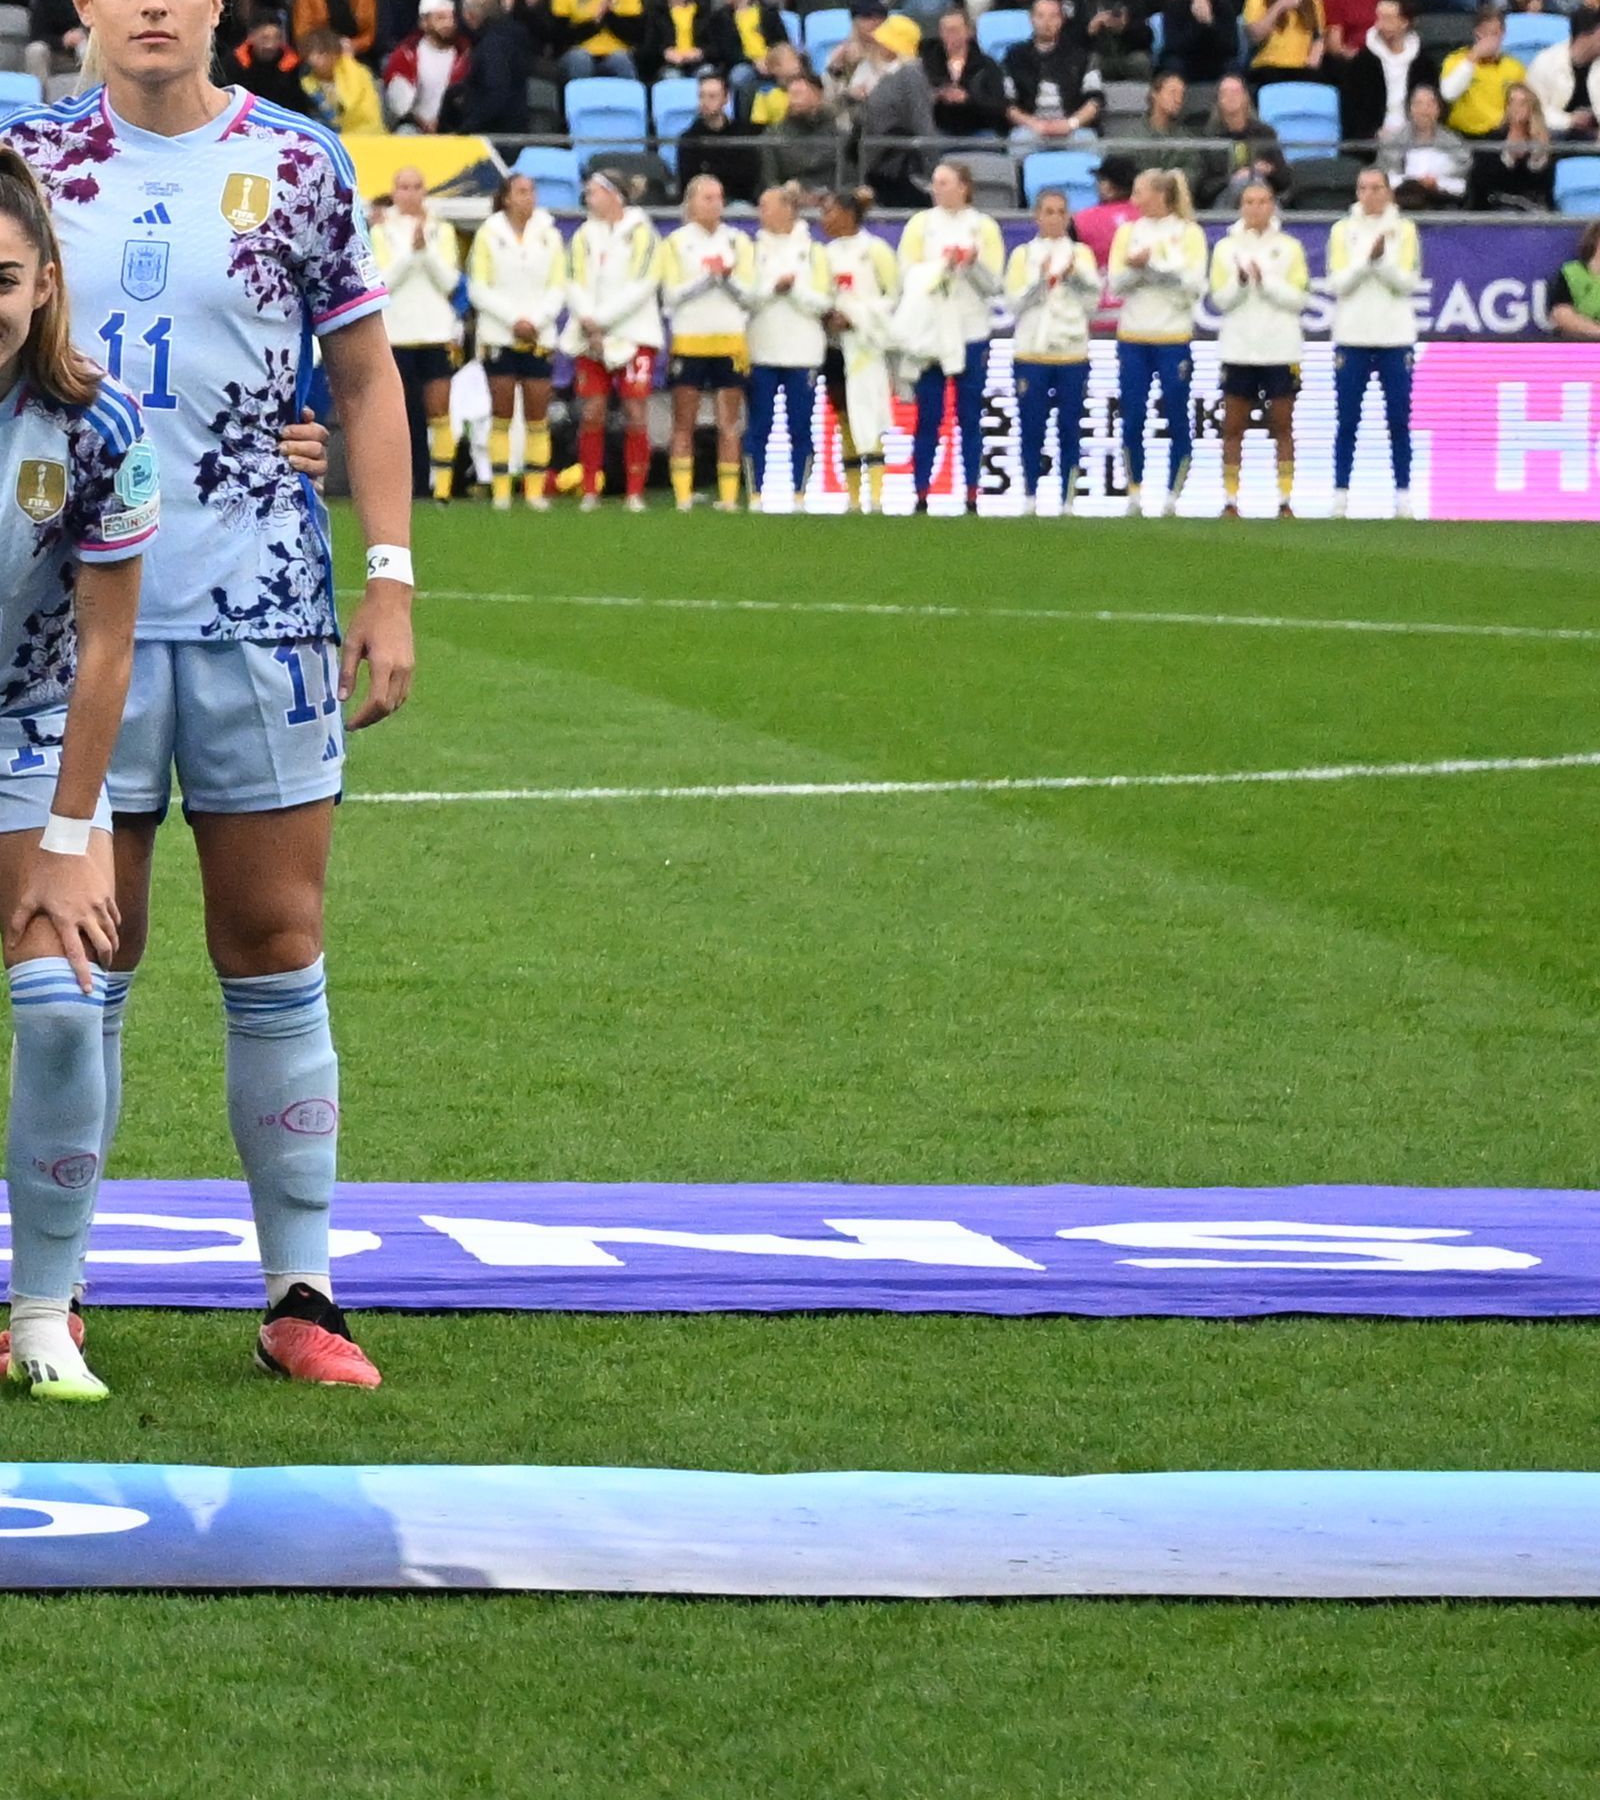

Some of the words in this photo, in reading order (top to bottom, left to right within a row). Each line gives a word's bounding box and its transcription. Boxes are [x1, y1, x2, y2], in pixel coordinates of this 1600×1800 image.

[1414, 278, 1552, 335] EAG
[96, 309, 179, 410] 11
[1493, 381, 1600, 494] H
